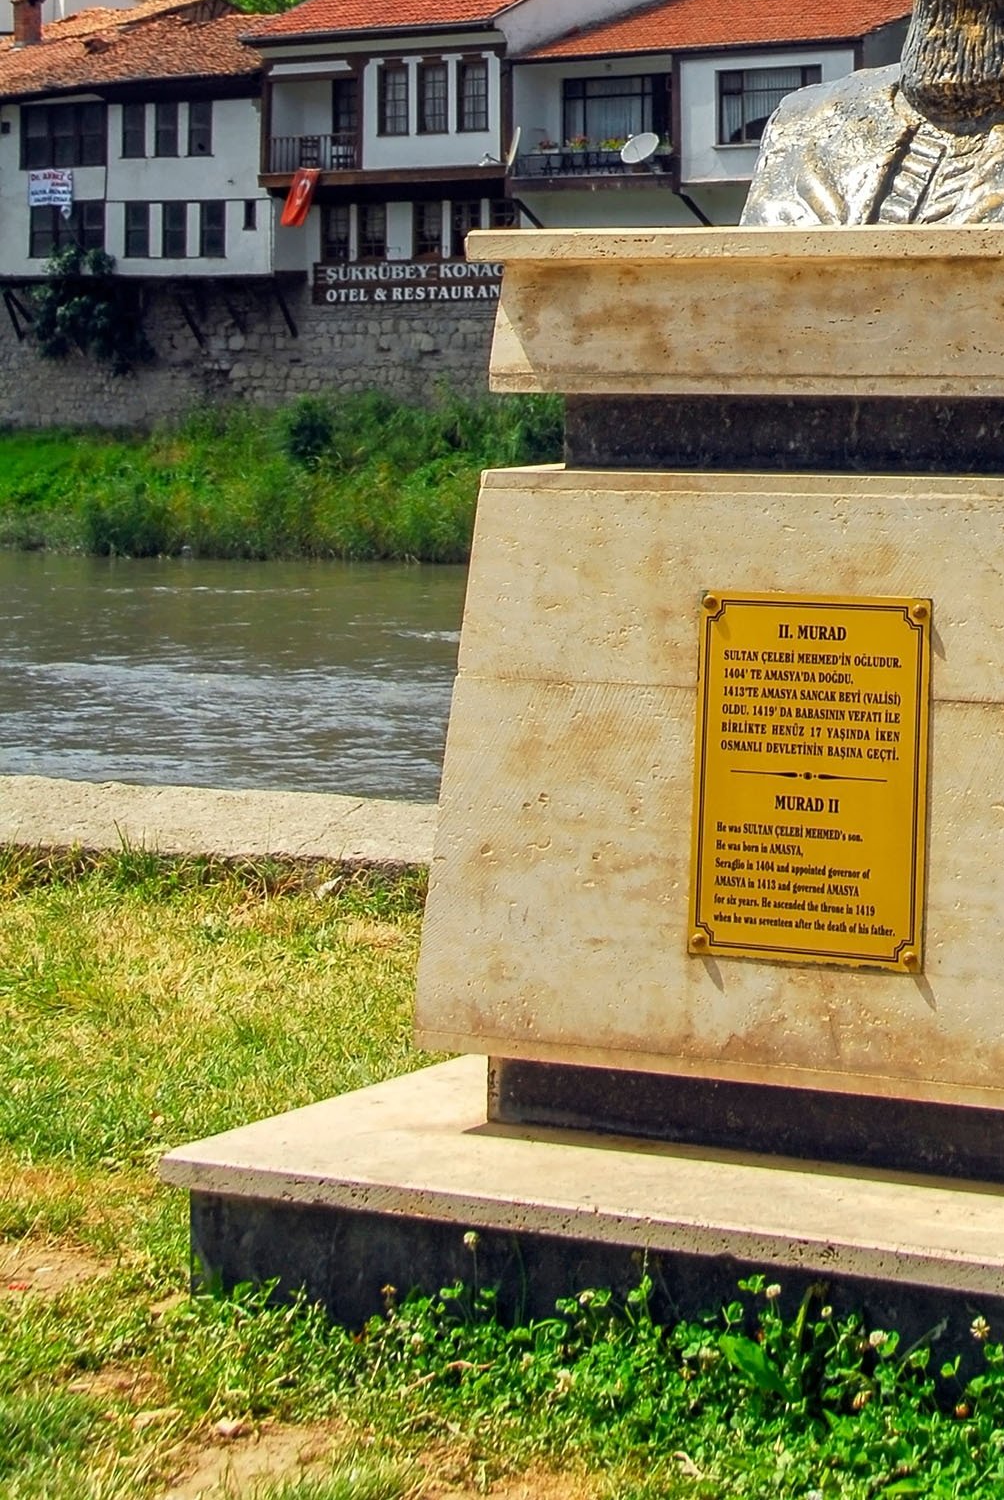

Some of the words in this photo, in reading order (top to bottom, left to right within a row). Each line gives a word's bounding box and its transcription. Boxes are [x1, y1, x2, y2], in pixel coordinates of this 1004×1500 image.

[326, 289, 368, 302] OTEL
[374, 288, 387, 300] &
[778, 624, 793, 639] II.
[797, 625, 847, 641] MURAD
[723, 649, 759, 662] SULTAN
[761, 650, 795, 665] ÇELEBİ
[797, 652, 851, 666] MEHMED'İN
[854, 653, 902, 668] OĞLUDUR.
[724, 668, 748, 679] 1404'
[750, 669, 762, 680] TE
[763, 669, 816, 683] AMASYA'DA
[818, 670, 854, 685] DOĞDU.
[723, 686, 759, 698] 1413'TE
[760, 687, 798, 700] AMASYA
[799, 689, 836, 702] SANCAK
[838, 689, 861, 703] BEYİ
[863, 691, 901, 707] (VALİSİ)
[722, 703, 749, 716] OLDU.
[753, 705, 778, 717] 1419'
[780, 706, 793, 718] DA
[795, 707, 846, 721] BABASININ
[848, 710, 882, 723] VEFATI
[884, 709, 901, 724] İLE
[721, 719, 767, 735] BİRLİKTE
[810, 726, 822, 738] 17
[827, 727, 870, 742] YAŞINDA
[875, 727, 900, 742] İKEN
[720, 739, 762, 753] OSMANLI
[766, 741, 824, 756] DEVLETİNİN
[827, 746, 863, 760] BAŞINA
[866, 747, 899, 763] GEÇTİ.
[774, 795, 824, 813] MURAD
[828, 798, 839, 814] II
[716, 821, 727, 832] He
[728, 825, 742, 834] was
[743, 823, 774, 836] SULTAN
[774, 824, 804, 839] ÇELEBİ
[804, 827, 846, 841] MEHMED's
[848, 834, 863, 842] son.
[716, 839, 726, 850] He
[727, 843, 741, 851] was
[742, 841, 759, 853] born
[760, 843, 768, 854] in
[769, 843, 804, 857] AMASYA,
[715, 857, 745, 872] Seraglio
[746, 859, 754, 871] in
[756, 860, 775, 872] 1404
[776, 862, 790, 873] and
[791, 864, 826, 877] appointed
[827, 867, 861, 879] governor
[862, 868, 871, 880] of
[714, 875, 746, 888] AMASYA
[747, 877, 755, 889] in
[757, 878, 776, 891] 1413
[777, 880, 791, 892] and
[792, 882, 825, 894] governed
[826, 884, 859, 897] AMASYA
[714, 893, 725, 904] for
[726, 894, 737, 905] six
[737, 898, 760, 908] years.
[761, 896, 772, 908] He
[773, 899, 806, 911] ascended
[807, 900, 819, 912] the
[820, 901, 844, 914] throne
[846, 904, 853, 915] in
[856, 904, 875, 917] 1419
[713, 911, 732, 923] when
[733, 912, 742, 924] he
[743, 916, 757, 925] was
[758, 917, 793, 928] seventeen
[794, 918, 812, 930] after
[814, 919, 825, 931] the
[827, 920, 847, 933] death
[848, 923, 857, 934] of
[858, 923, 869, 935] his
[870, 924, 896, 937] father.
